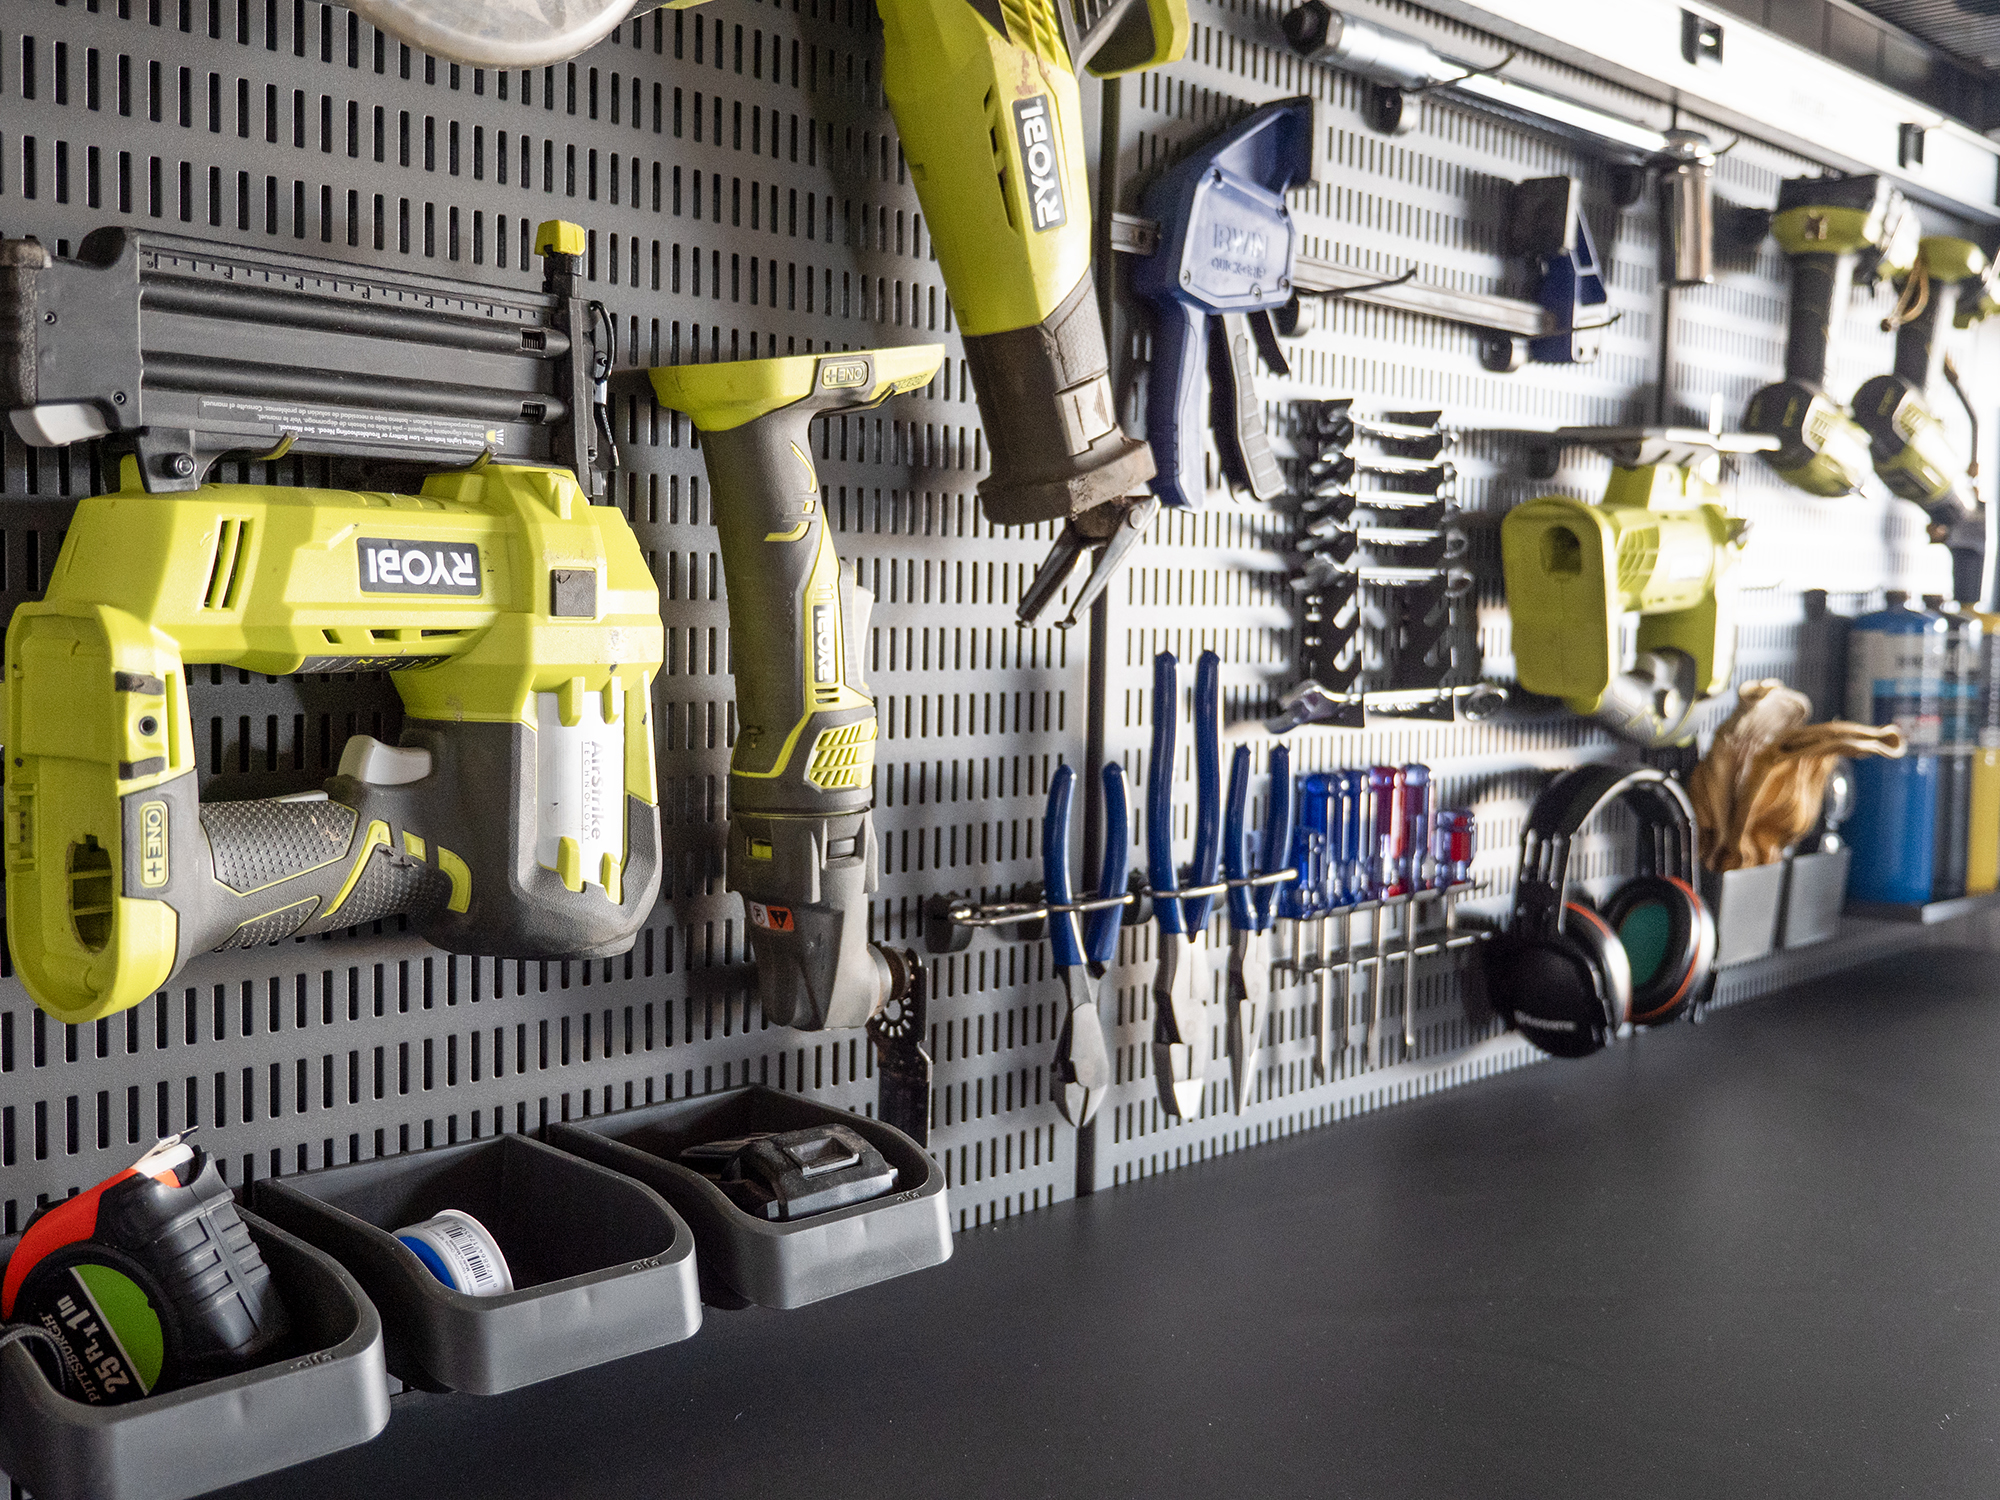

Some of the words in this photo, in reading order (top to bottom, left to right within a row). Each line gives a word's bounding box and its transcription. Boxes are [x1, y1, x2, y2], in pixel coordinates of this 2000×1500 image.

[1020, 105, 1061, 228] RYOBI
[826, 367, 864, 383] ONE+
[202, 400, 229, 408] manual.
[237, 404, 263, 412] Consulte
[336, 428, 381, 439] Troubleshooting
[389, 432, 409, 441] Battery
[425, 435, 446, 443] Indicate
[447, 437, 462, 445] Lights
[463, 439, 485, 447] Flashing
[367, 548, 477, 586] RYOBI
[591, 741, 604, 840] AirStrike
[147, 809, 162, 878] ONE+
[66, 1309, 90, 1330] 1
[41, 1314, 101, 1402] PITTSBURGH
[84, 1338, 104, 1363] Ft.
[94, 1356, 129, 1394] 25
